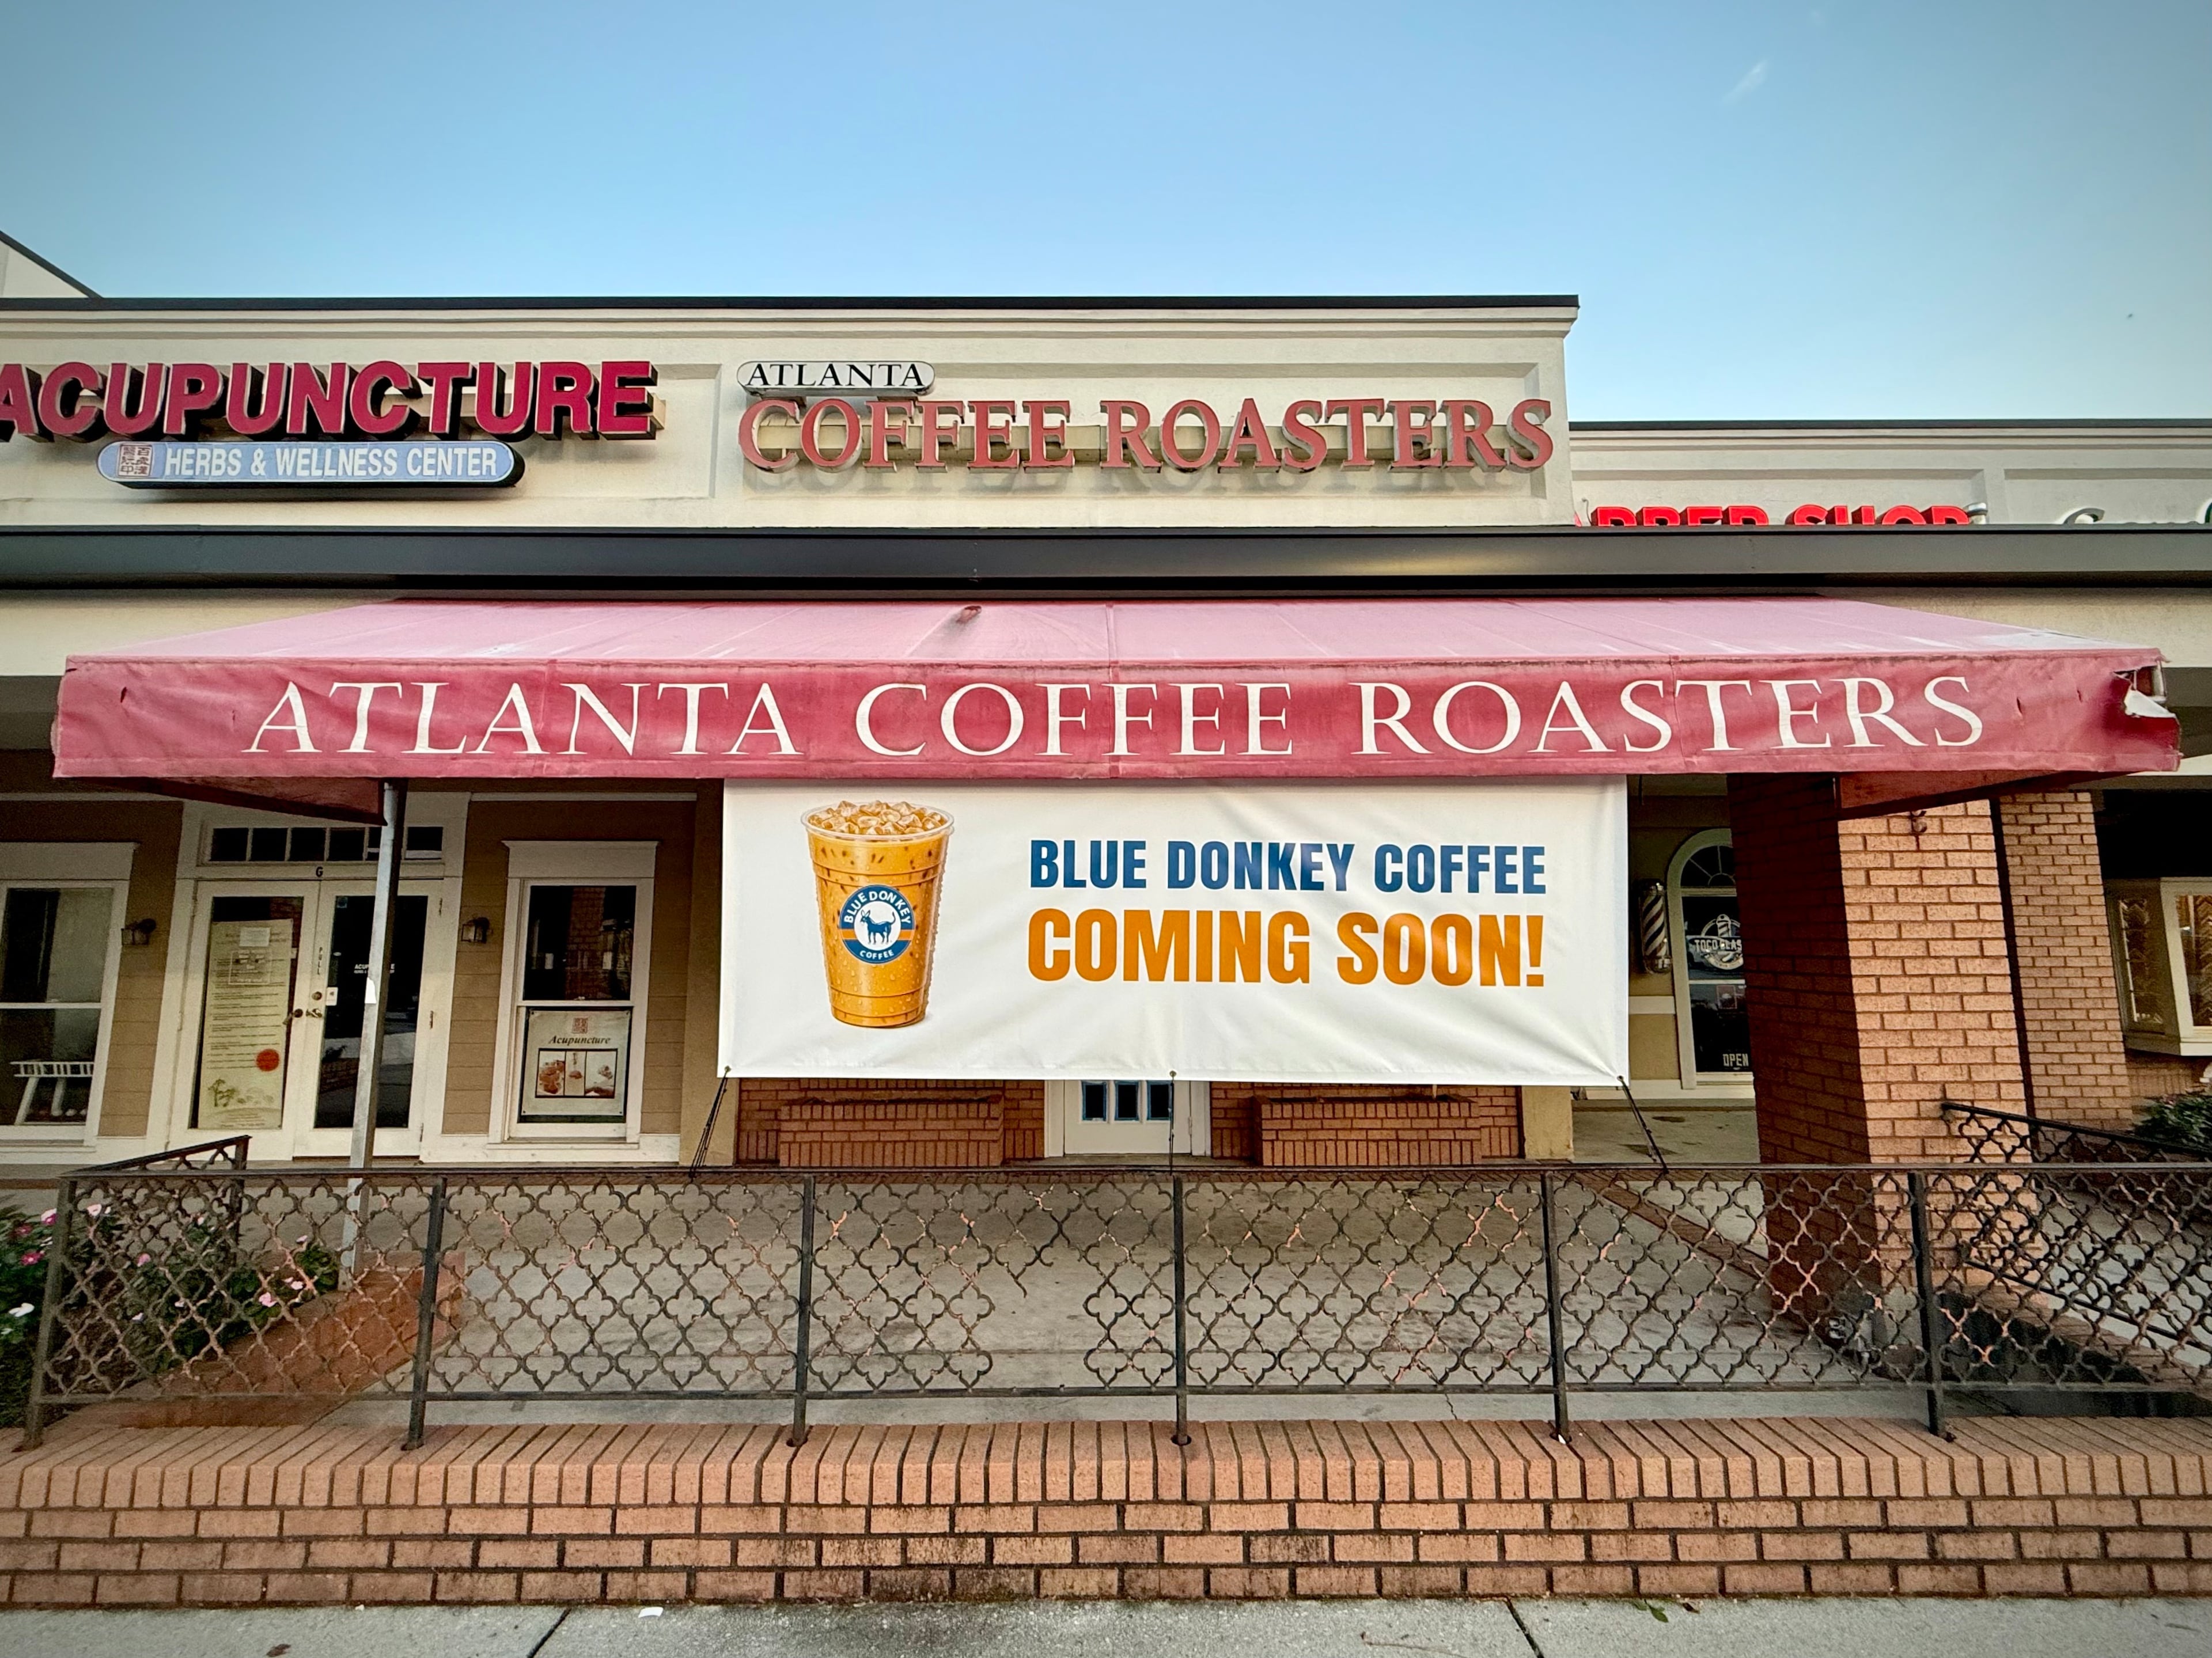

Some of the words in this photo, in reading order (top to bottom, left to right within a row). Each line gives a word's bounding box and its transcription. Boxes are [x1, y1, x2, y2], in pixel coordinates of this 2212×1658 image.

[745, 363, 925, 387] ATLANTA
[0, 361, 656, 436] ACUPUNCTURE
[738, 398, 1075, 474] COFFEE
[1099, 397, 1554, 474] ROASTERS
[165, 448, 243, 476] HERBS
[250, 448, 266, 476] &
[275, 447, 398, 476] WELLNESS
[407, 447, 497, 476] CENTER
[240, 680, 805, 756] ATLANTA
[855, 682, 1294, 757] COFFEE
[1349, 675, 1983, 756] ROASTERS
[316, 866, 323, 878] G
[1029, 840, 1147, 890] BLUE
[1166, 840, 1355, 892] DONKEY
[1373, 844, 1546, 894] COFFEE
[843, 891, 868, 924] BLUE
[868, 890, 911, 924] DONKEY
[859, 950, 894, 960] COFFEE
[1028, 907, 1310, 985] COMING
[1336, 911, 1544, 987] SOON!
[1719, 939, 1742, 953] CLAS
[549, 1035, 611, 1046] Acupuncture
[1722, 1053, 1749, 1067] OPEN
